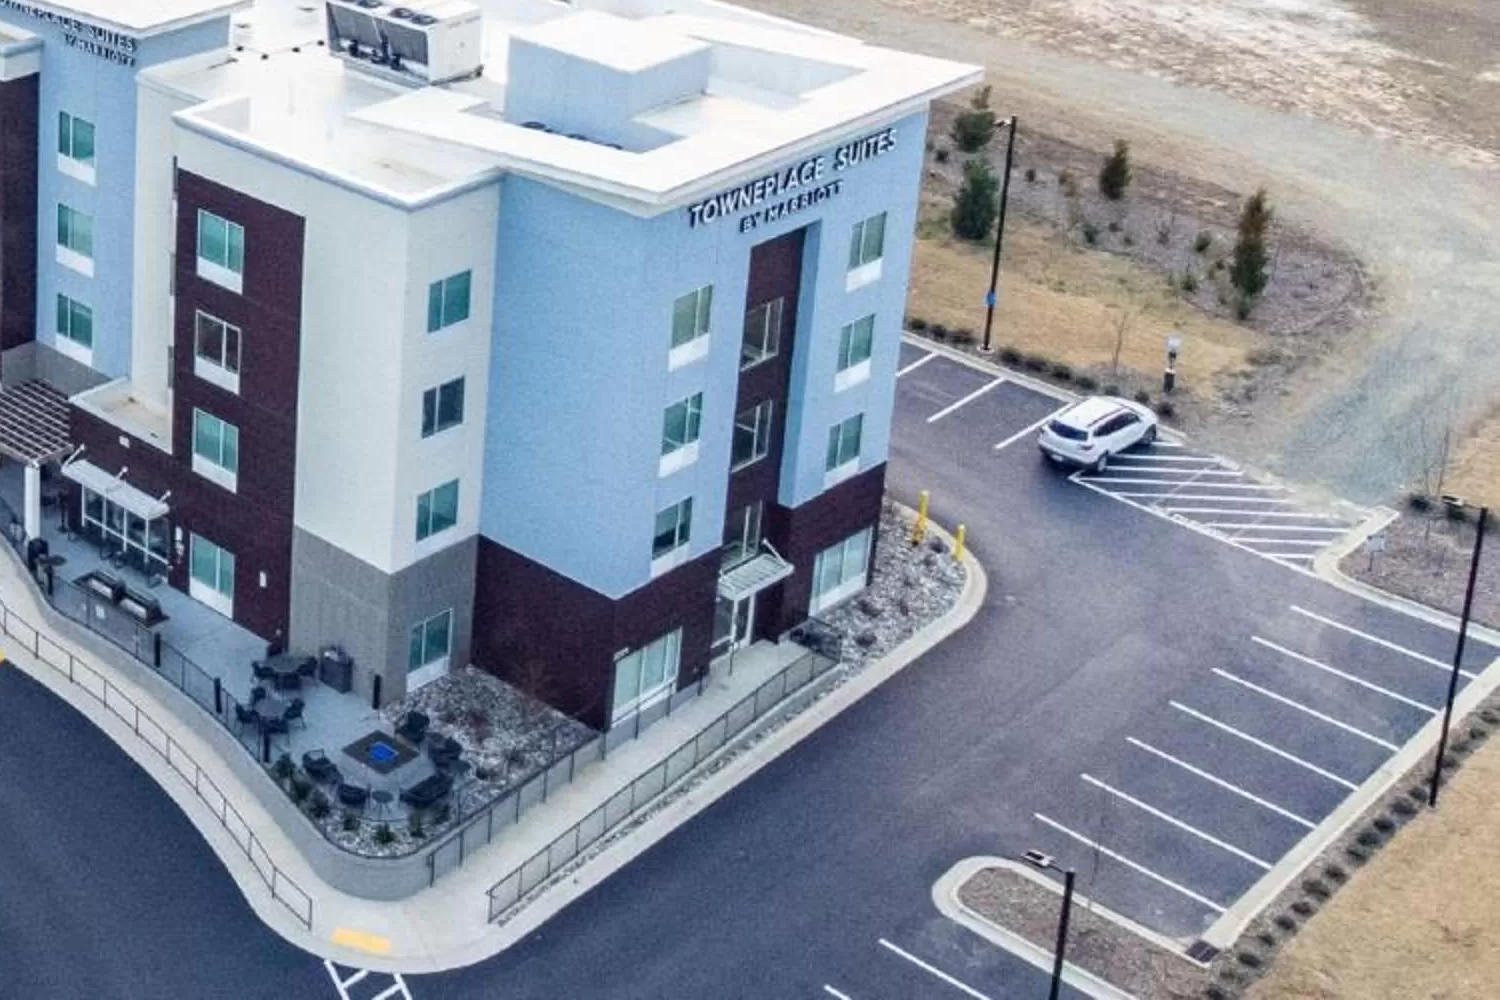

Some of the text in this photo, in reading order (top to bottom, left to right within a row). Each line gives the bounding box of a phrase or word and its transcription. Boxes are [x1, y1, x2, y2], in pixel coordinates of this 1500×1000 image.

[689, 128, 897, 228] TOWNEPLACE SUITES
[740, 179, 844, 233] BY MARRIOTT
